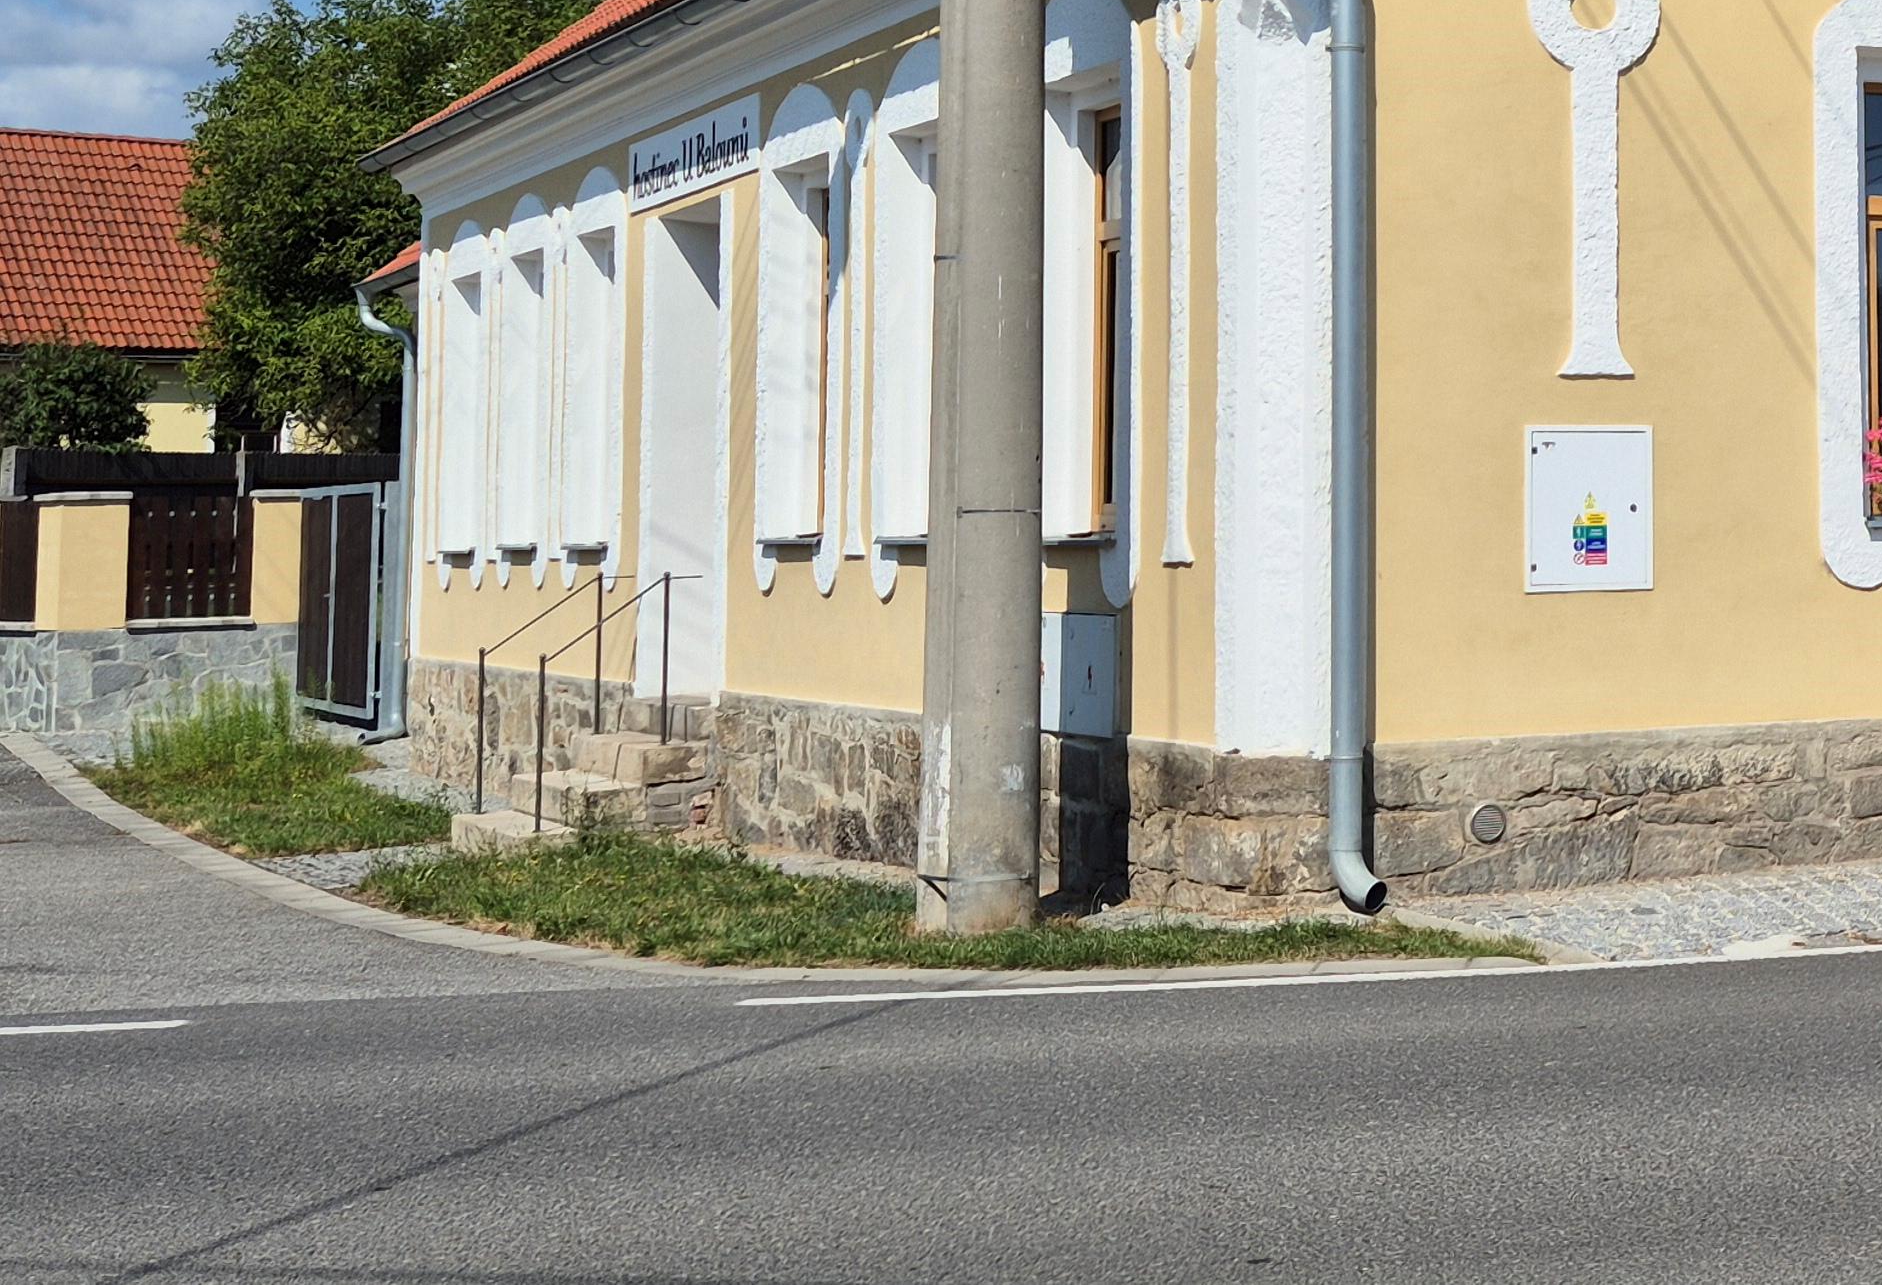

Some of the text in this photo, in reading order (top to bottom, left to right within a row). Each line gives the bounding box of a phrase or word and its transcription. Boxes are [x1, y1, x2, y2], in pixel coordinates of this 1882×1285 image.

[633, 116, 749, 200] hostinec U Balounů
